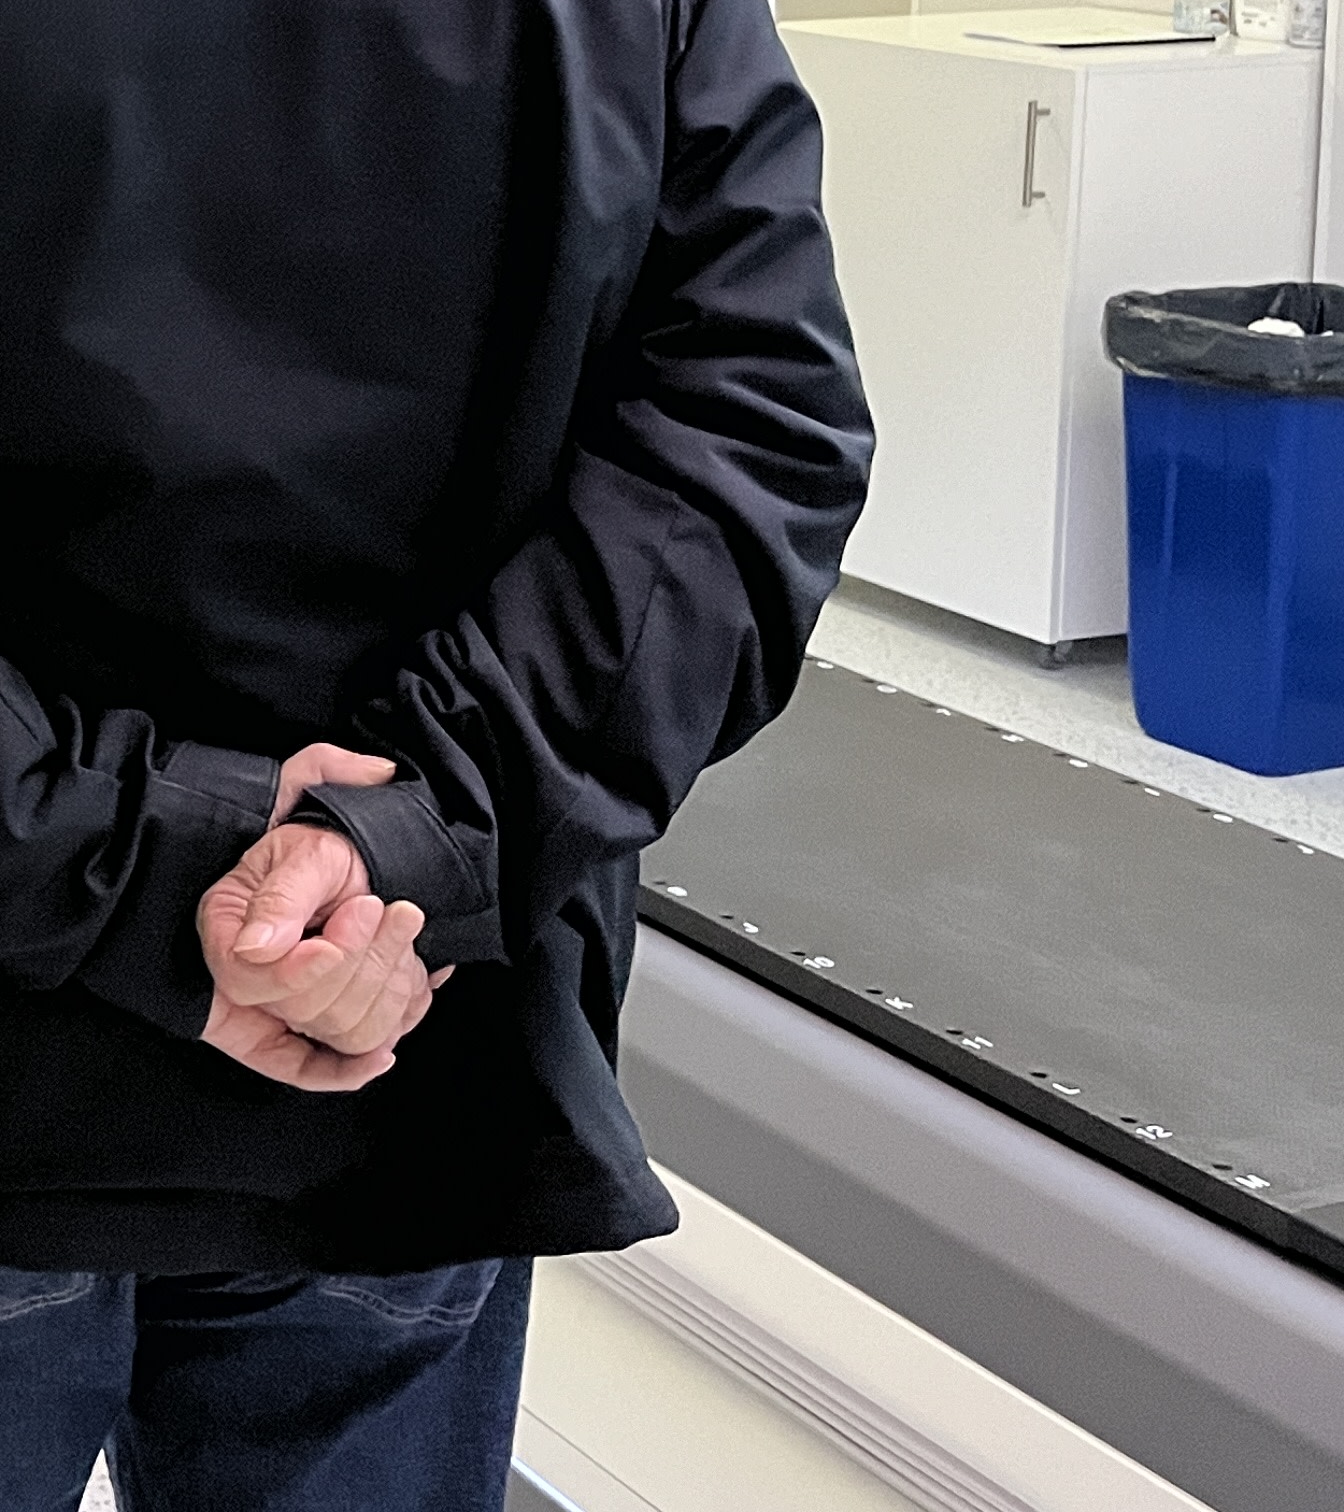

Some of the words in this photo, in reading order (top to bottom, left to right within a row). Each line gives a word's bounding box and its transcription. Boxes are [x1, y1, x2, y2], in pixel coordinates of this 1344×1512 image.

[803, 956, 835, 969] 10
[885, 997, 913, 1010] K
[1052, 1083, 1081, 1095] L
[1135, 1125, 1173, 1140] 12
[1235, 1174, 1270, 1189] M
